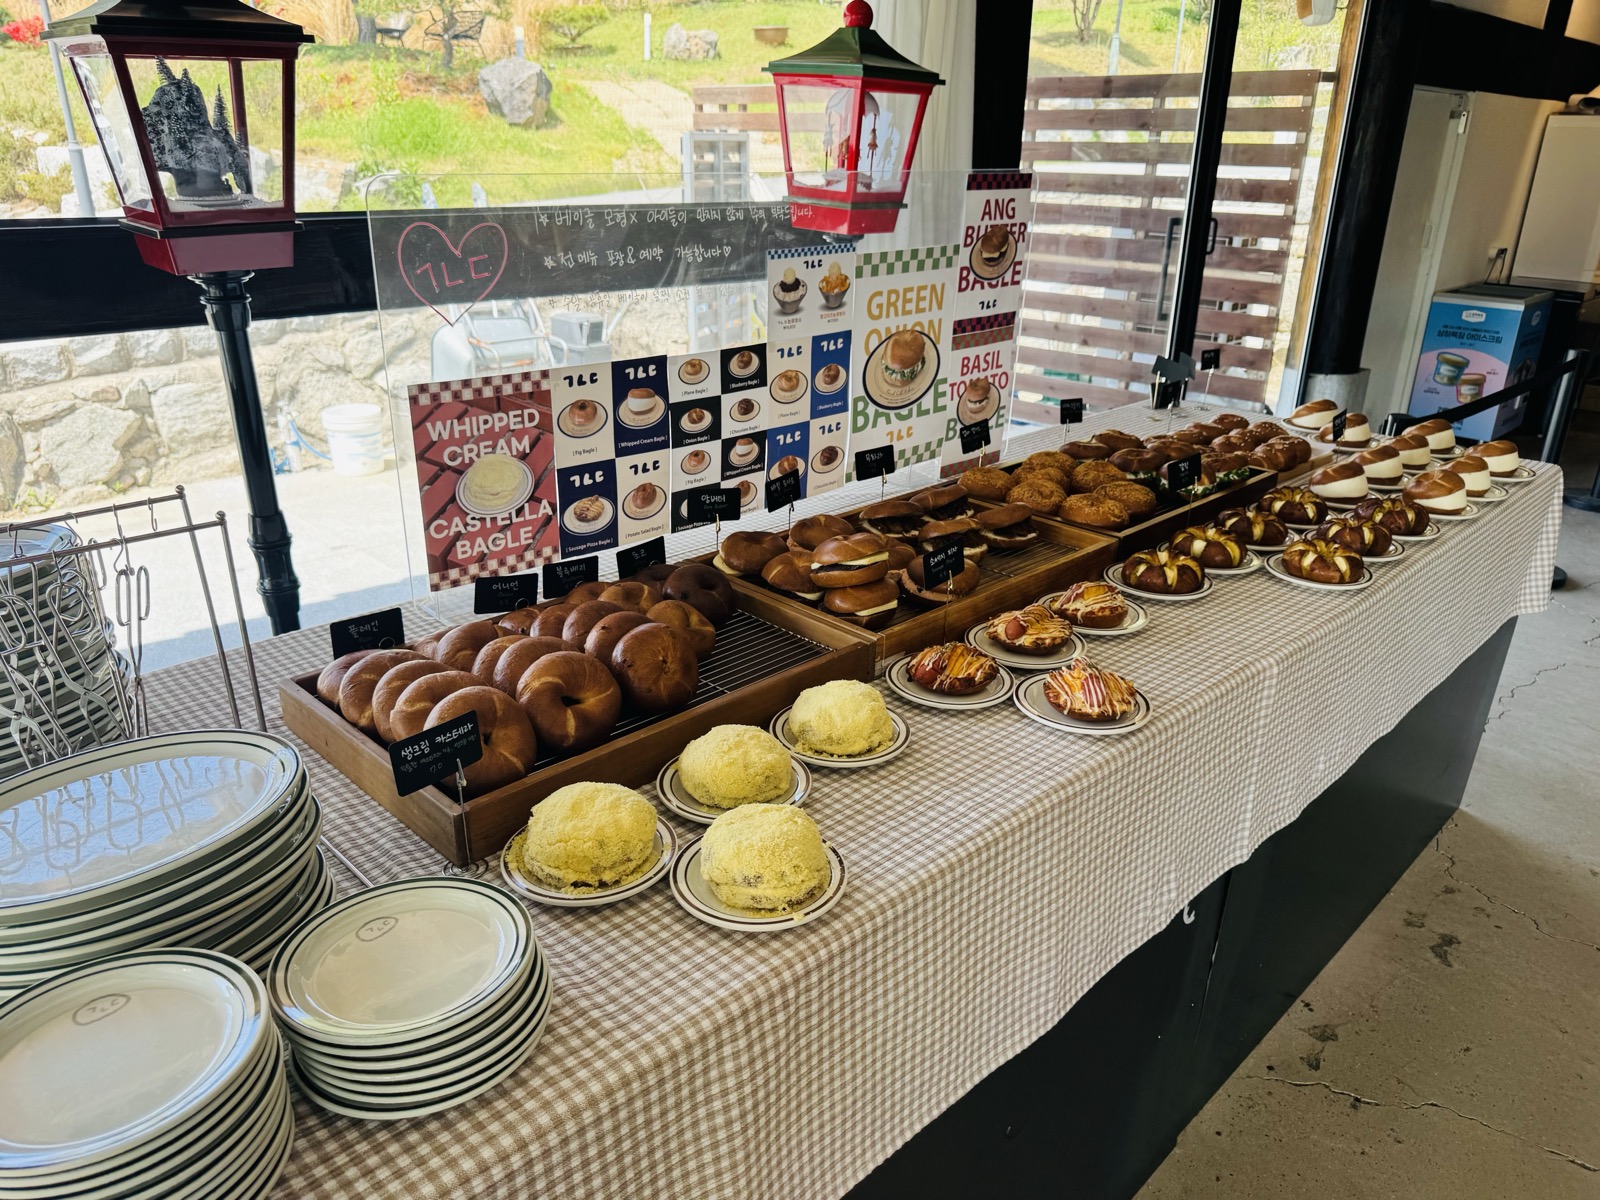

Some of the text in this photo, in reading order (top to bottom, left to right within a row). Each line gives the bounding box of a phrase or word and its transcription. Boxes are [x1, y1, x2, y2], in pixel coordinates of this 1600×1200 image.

[555, 207, 594, 229] 베이글
[980, 198, 1016, 222] ANG
[866, 282, 946, 321] GREEN
[1466, 331, 1503, 344] 아이스크림
[960, 350, 1003, 377] BASIL
[426, 408, 540, 442] WHIPPED
[443, 434, 531, 466] CREAM
[582, 447, 595, 455] Bagle
[621, 439, 639, 449] Whipped
[654, 436, 665, 444] Bagle
[701, 494, 726, 504] 앙버터
[429, 499, 553, 539] CASTELLA
[456, 526, 534, 560] BAGLE
[568, 544, 587, 552] Sausage
[598, 538, 611, 546] Bagle
[556, 563, 586, 578] 블루베리
[492, 580, 519, 591] 어니언
[347, 620, 379, 639] 플레인
[434, 722, 474, 743] 카스테라
